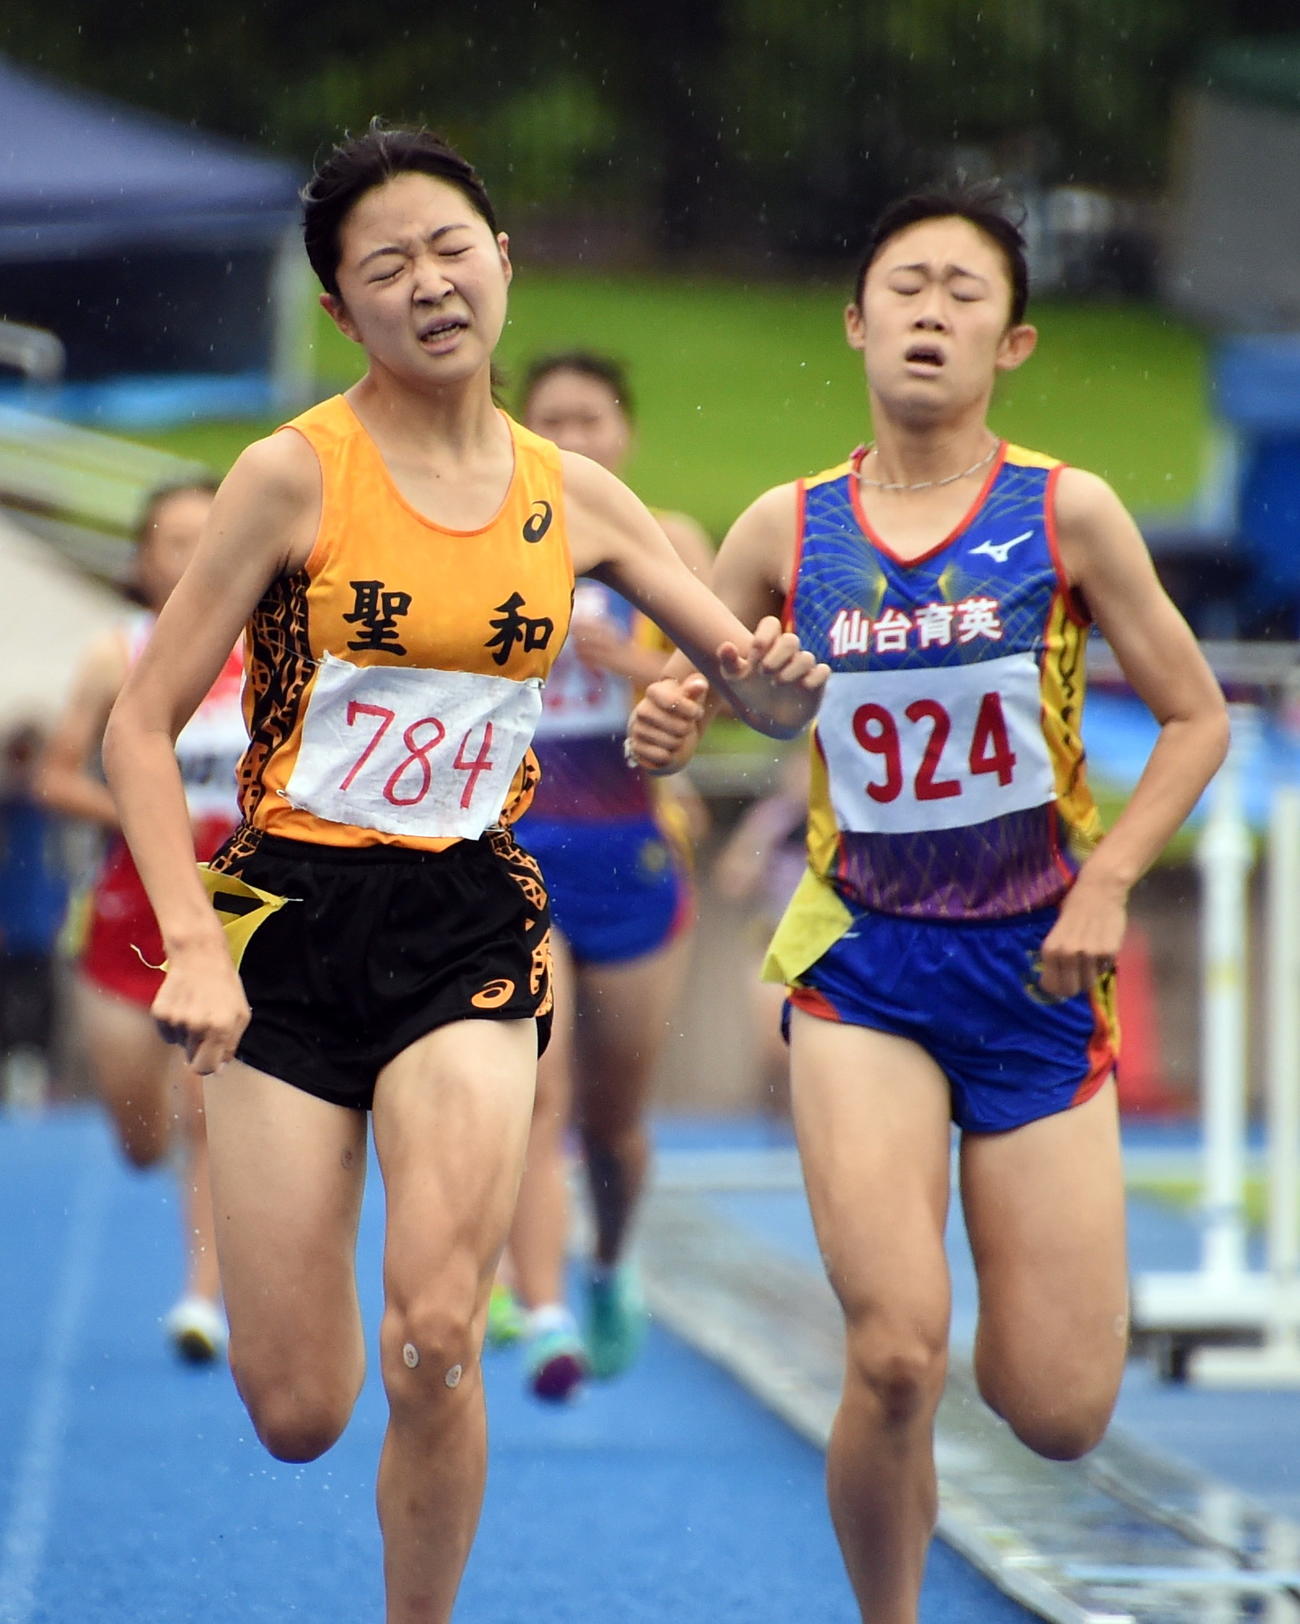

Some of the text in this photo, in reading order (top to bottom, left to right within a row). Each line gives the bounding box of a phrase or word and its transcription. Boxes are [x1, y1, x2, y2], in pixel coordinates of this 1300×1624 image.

[830, 597, 1002, 657] 仙台育英
[339, 701, 493, 809] 784
[852, 691, 1016, 803] 924
